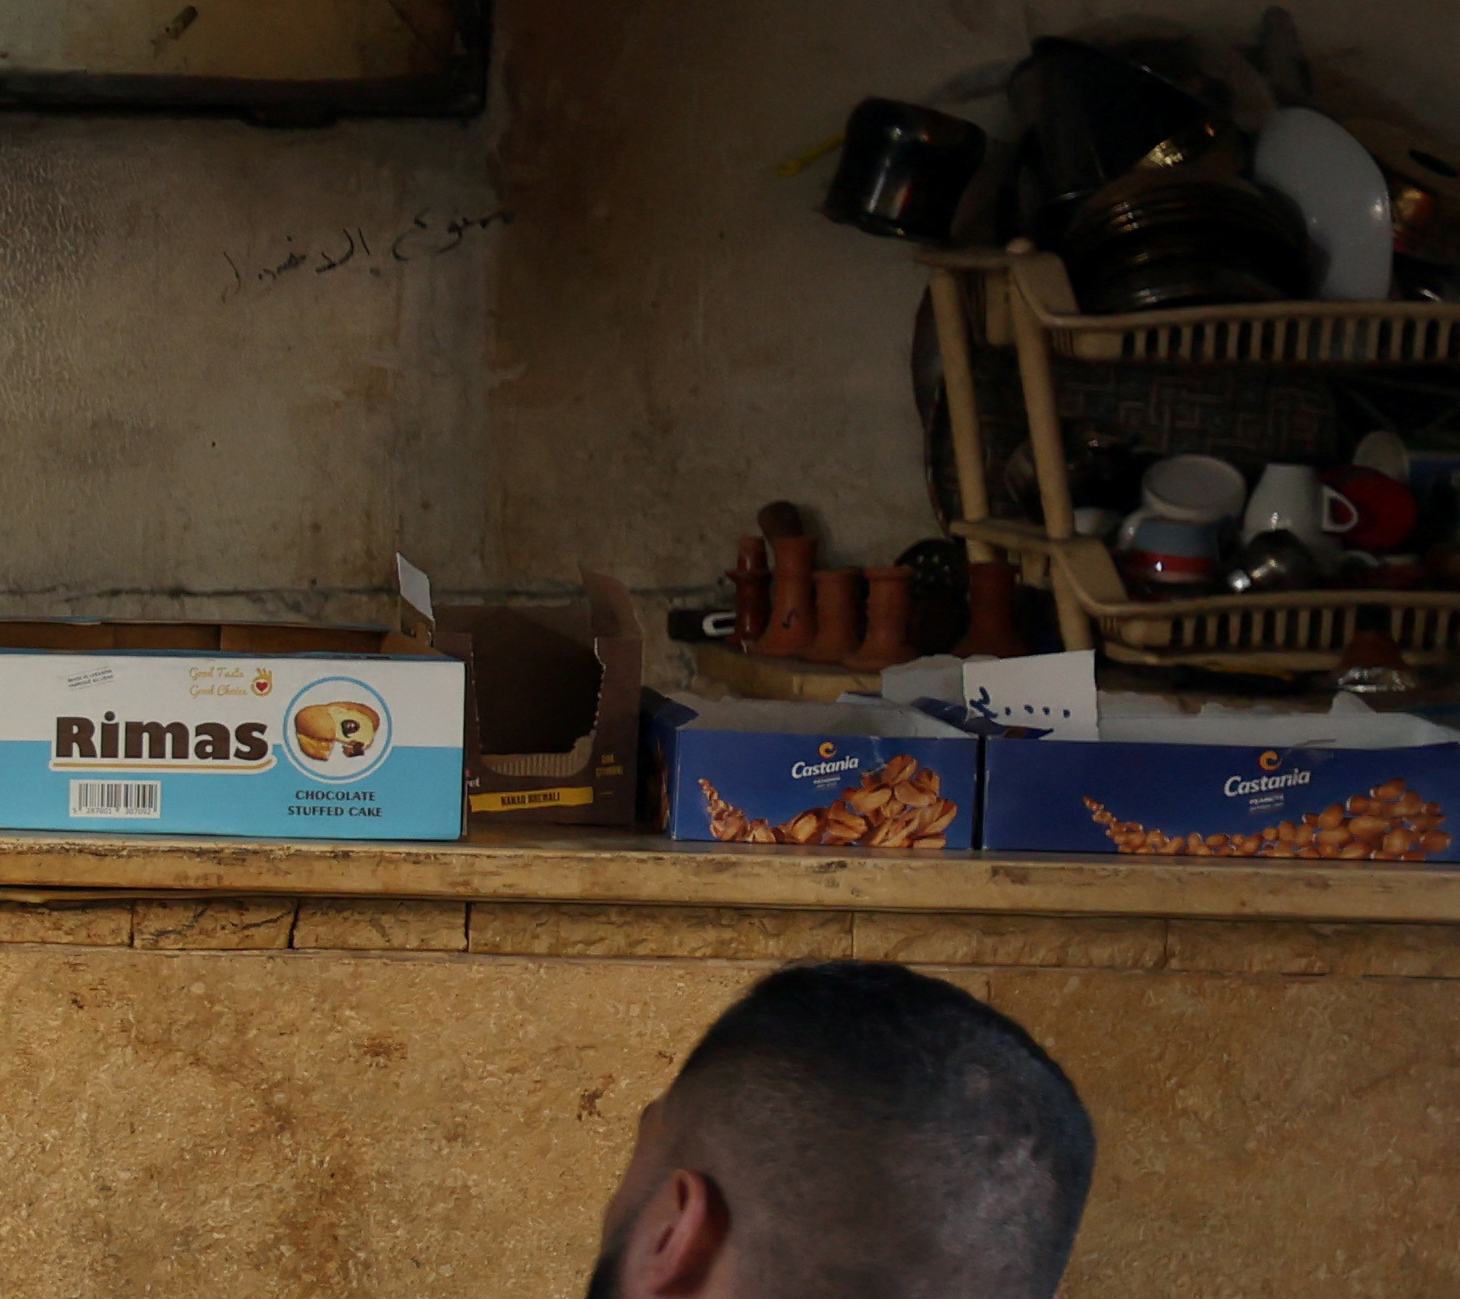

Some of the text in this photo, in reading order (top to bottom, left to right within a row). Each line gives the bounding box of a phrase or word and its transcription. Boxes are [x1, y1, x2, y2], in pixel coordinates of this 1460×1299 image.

[54, 710, 270, 764] Rimas
[791, 755, 859, 780] Castania
[295, 790, 376, 801] CHOCOLATE
[1224, 767, 1311, 799] Castania
[288, 805, 383, 817] STUFFED CAKE
